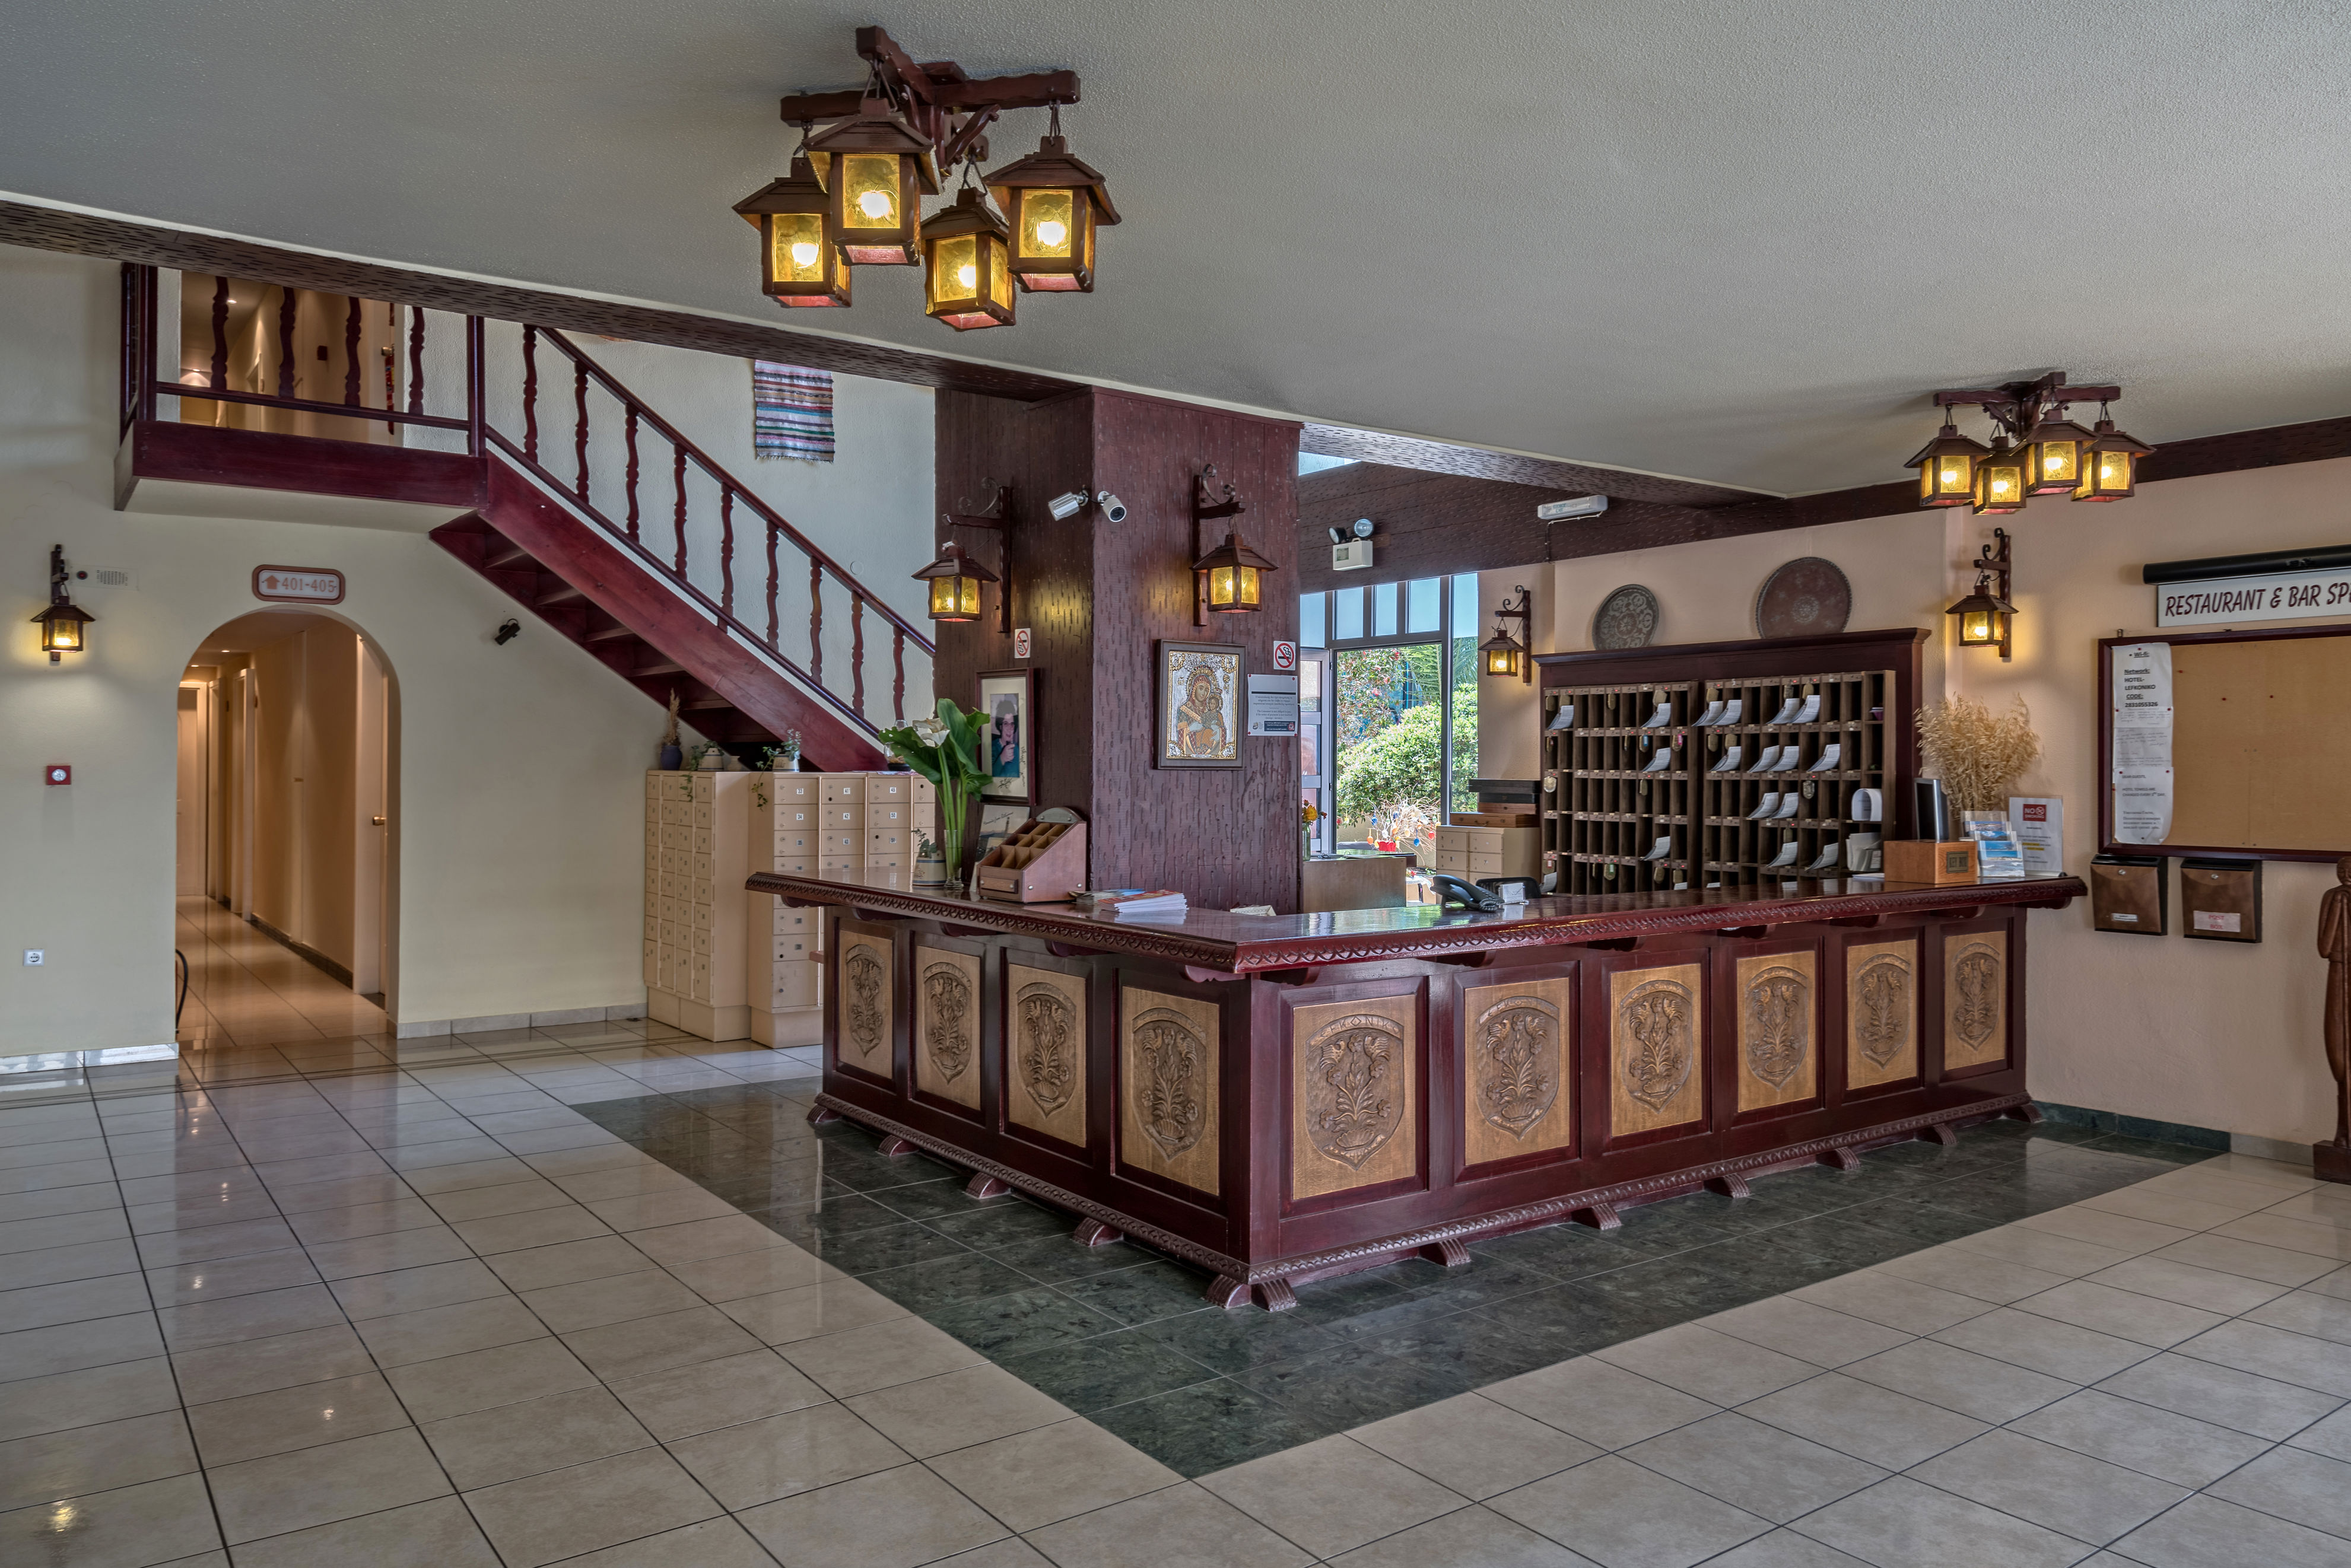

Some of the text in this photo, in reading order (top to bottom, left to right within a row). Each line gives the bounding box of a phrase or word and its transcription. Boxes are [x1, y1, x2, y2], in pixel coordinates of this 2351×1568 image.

[281, 577, 335, 593] 401-405
[2165, 581, 2351, 617] RESTAURANT & BAR SP
[1309, 1016, 1400, 1046] EFKONIKO
